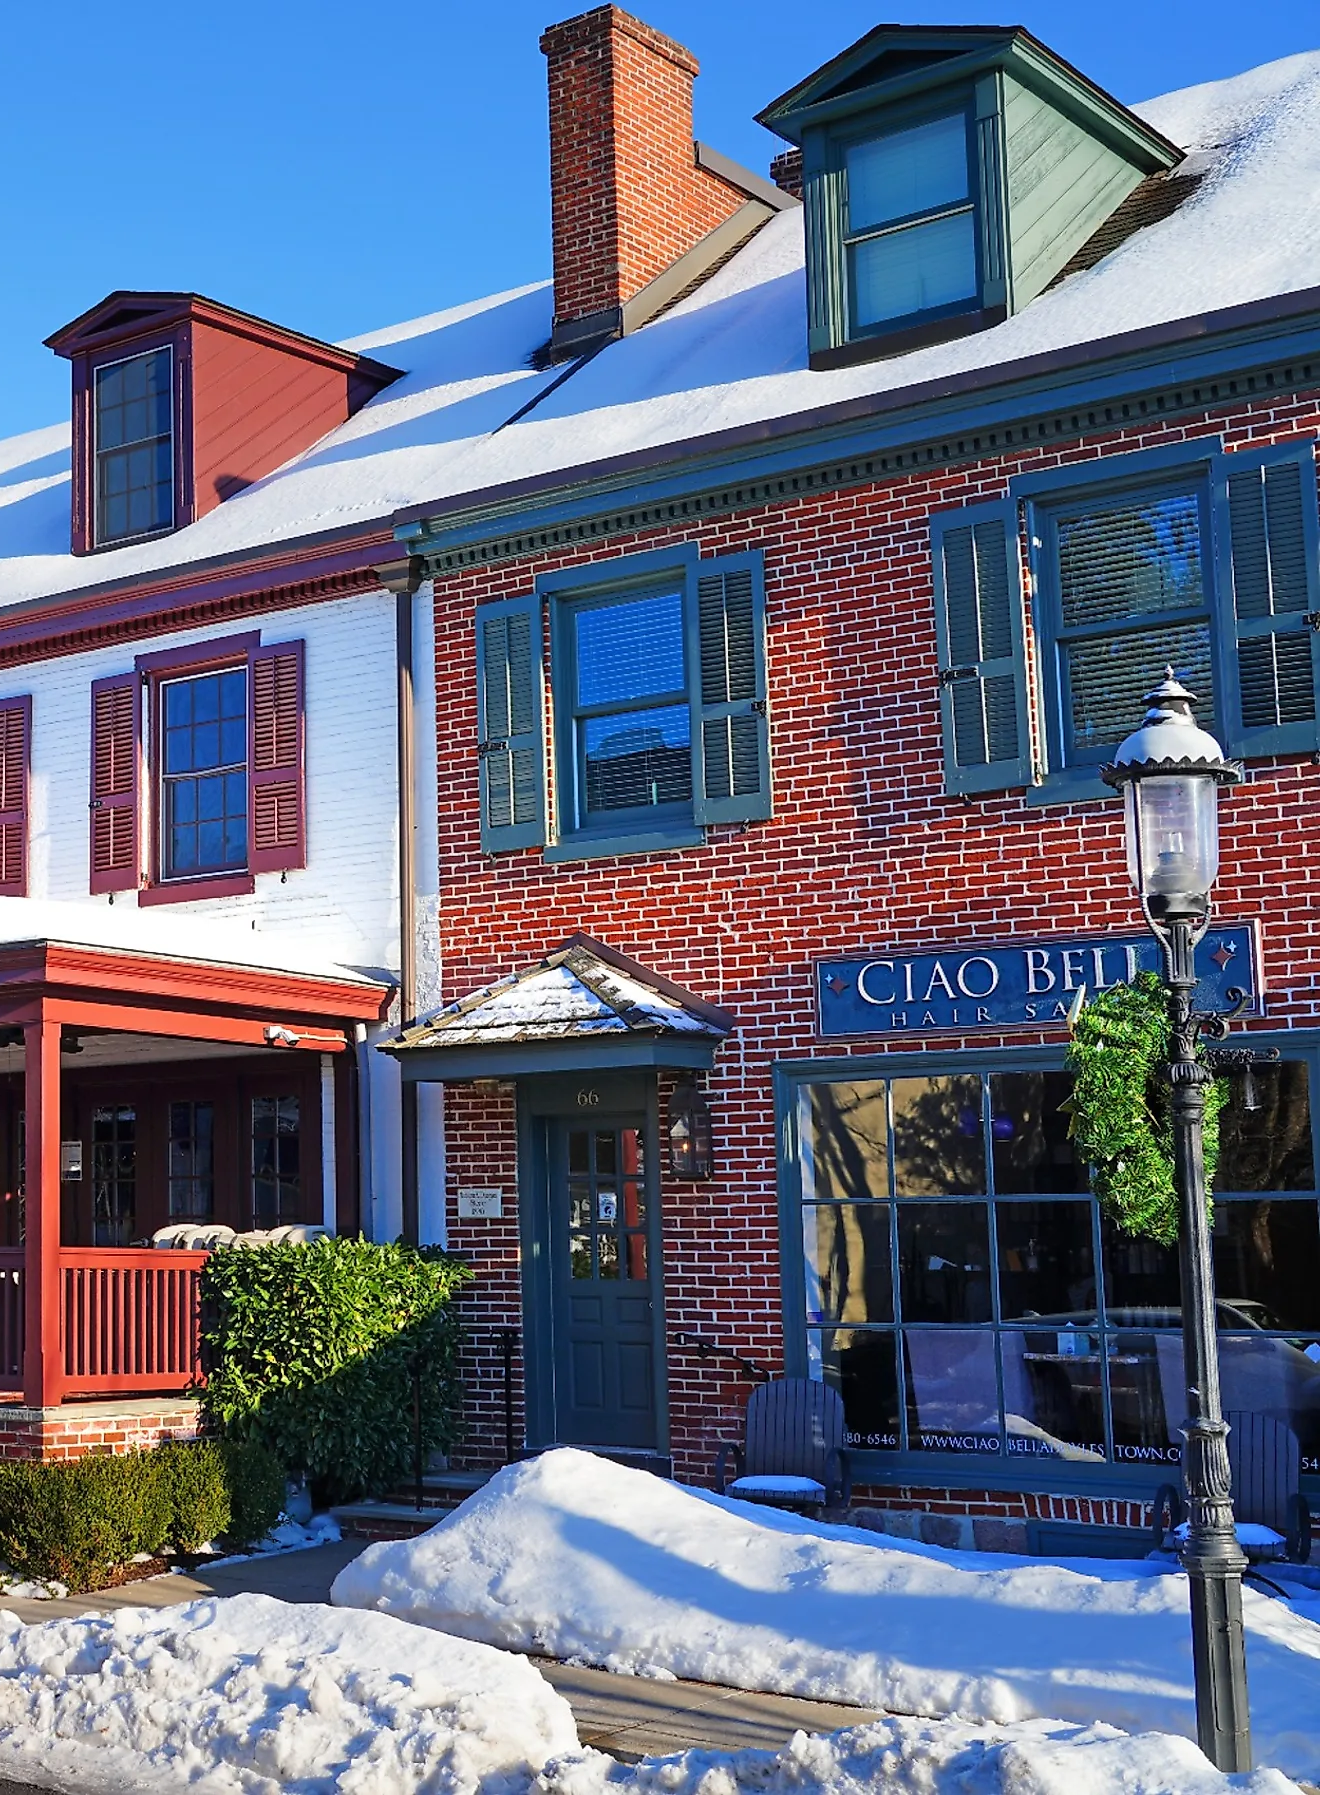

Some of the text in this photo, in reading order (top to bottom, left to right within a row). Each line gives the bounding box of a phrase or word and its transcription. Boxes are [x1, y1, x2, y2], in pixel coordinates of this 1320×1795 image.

[857, 956, 999, 1005] CIAO
[891, 1007, 991, 1028] HAIR
[577, 1089, 599, 1106] 66
